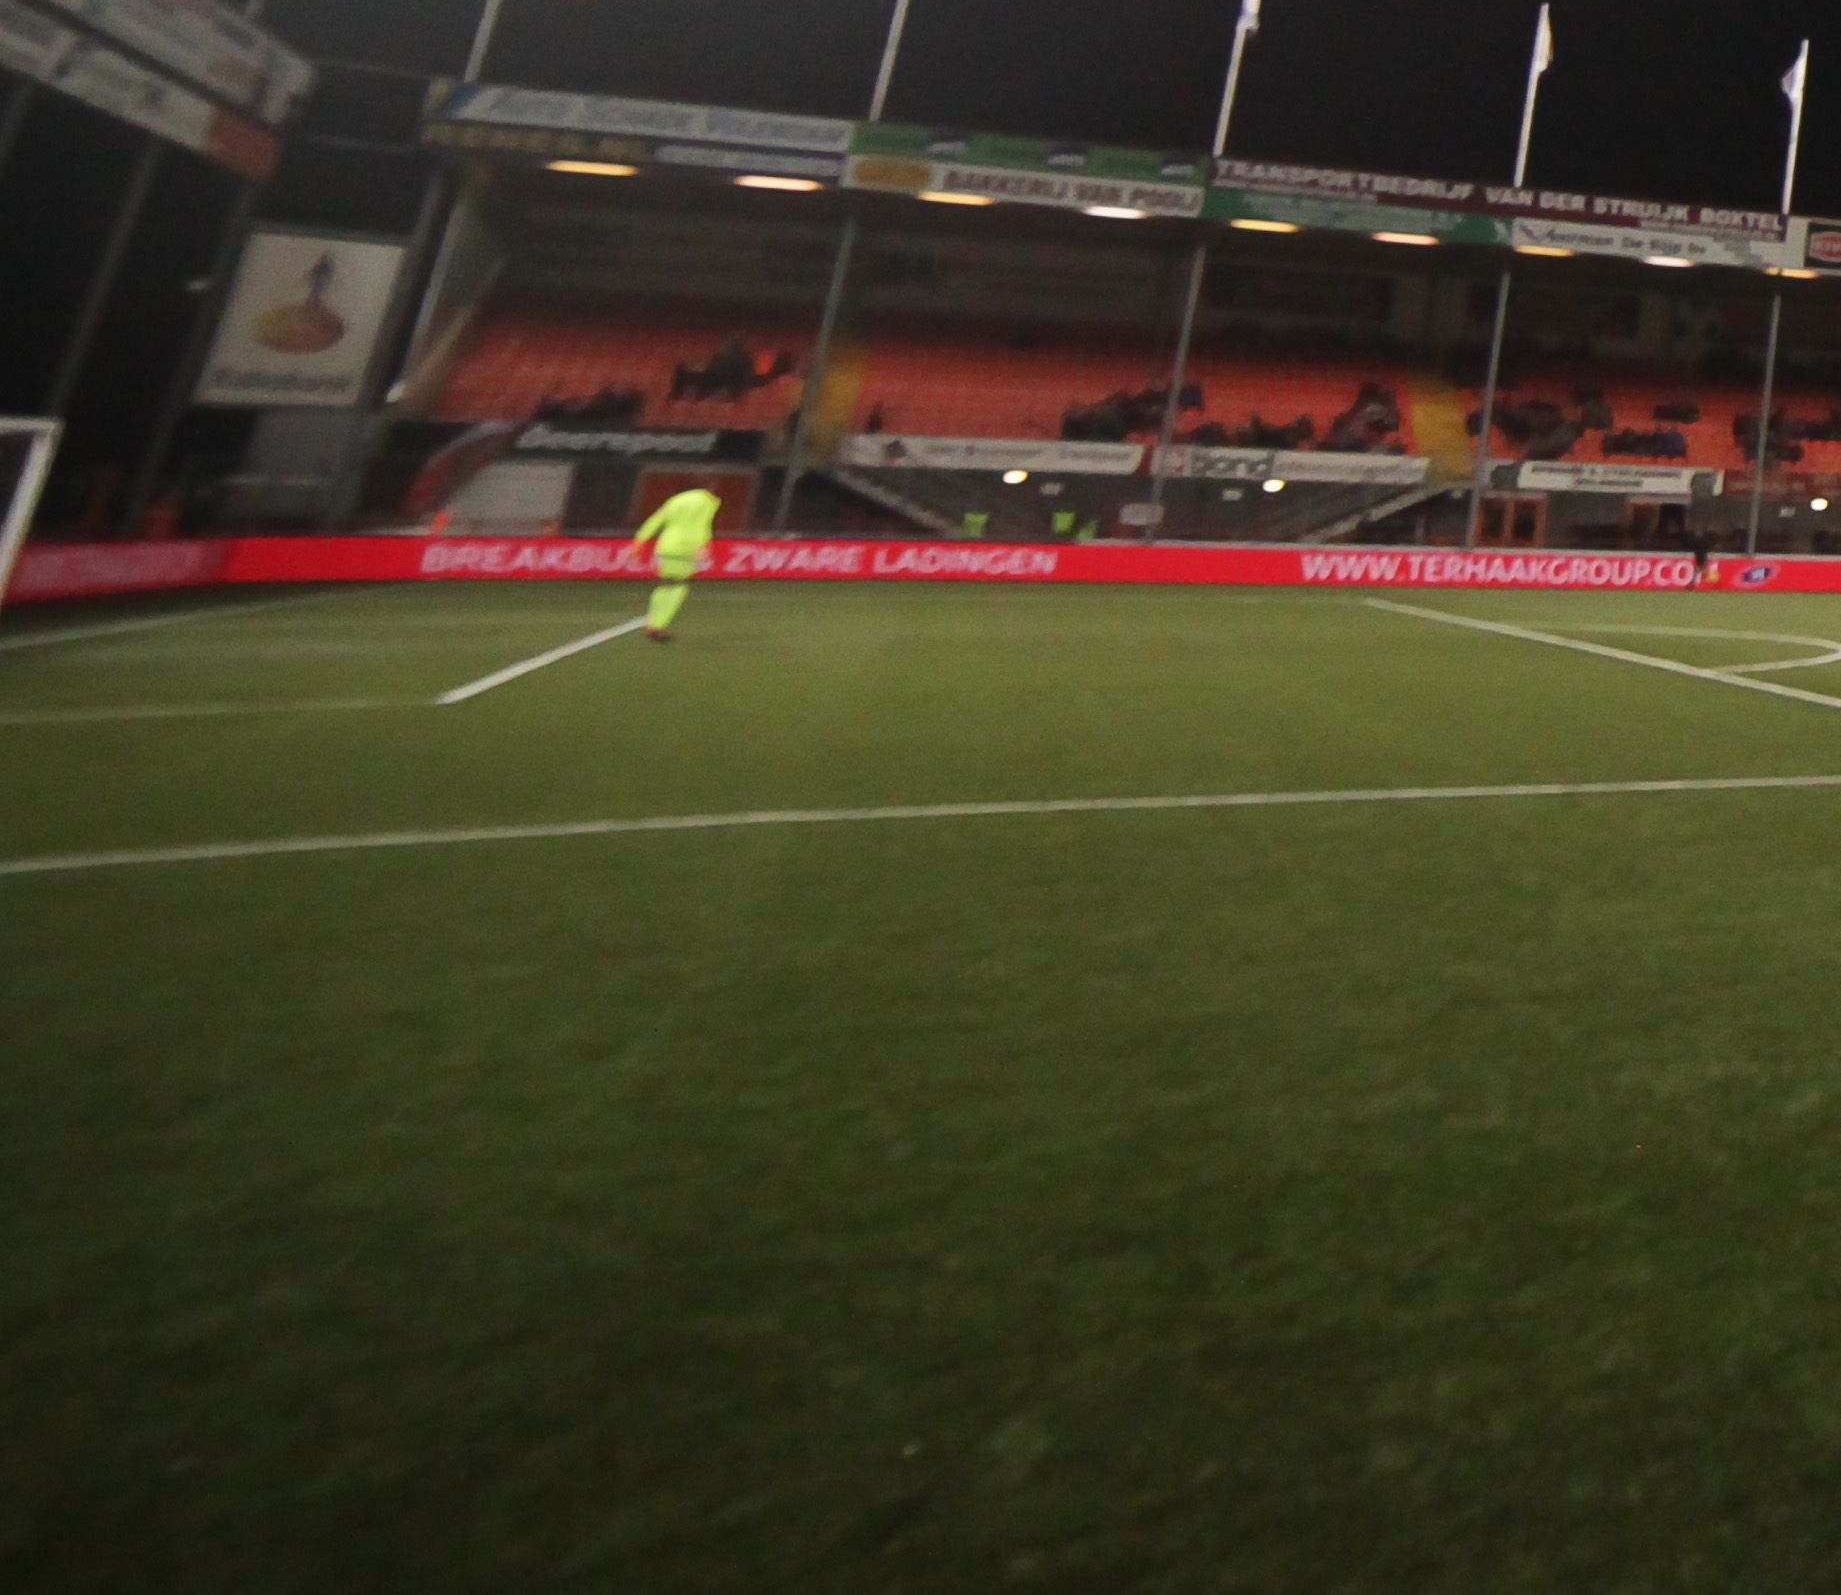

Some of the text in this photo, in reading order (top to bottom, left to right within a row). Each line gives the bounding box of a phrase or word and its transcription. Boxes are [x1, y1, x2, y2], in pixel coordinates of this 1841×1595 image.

[1216, 159, 1474, 201] TRANSPORTBEDRIJF
[1485, 187, 1533, 207] VAN
[1539, 191, 1585, 212] DER
[1593, 197, 1689, 222] STRUIJK
[1700, 207, 1783, 231] BOXTEL
[726, 546, 867, 574] ZWARE
[873, 548, 1058, 576] LADINGEN
